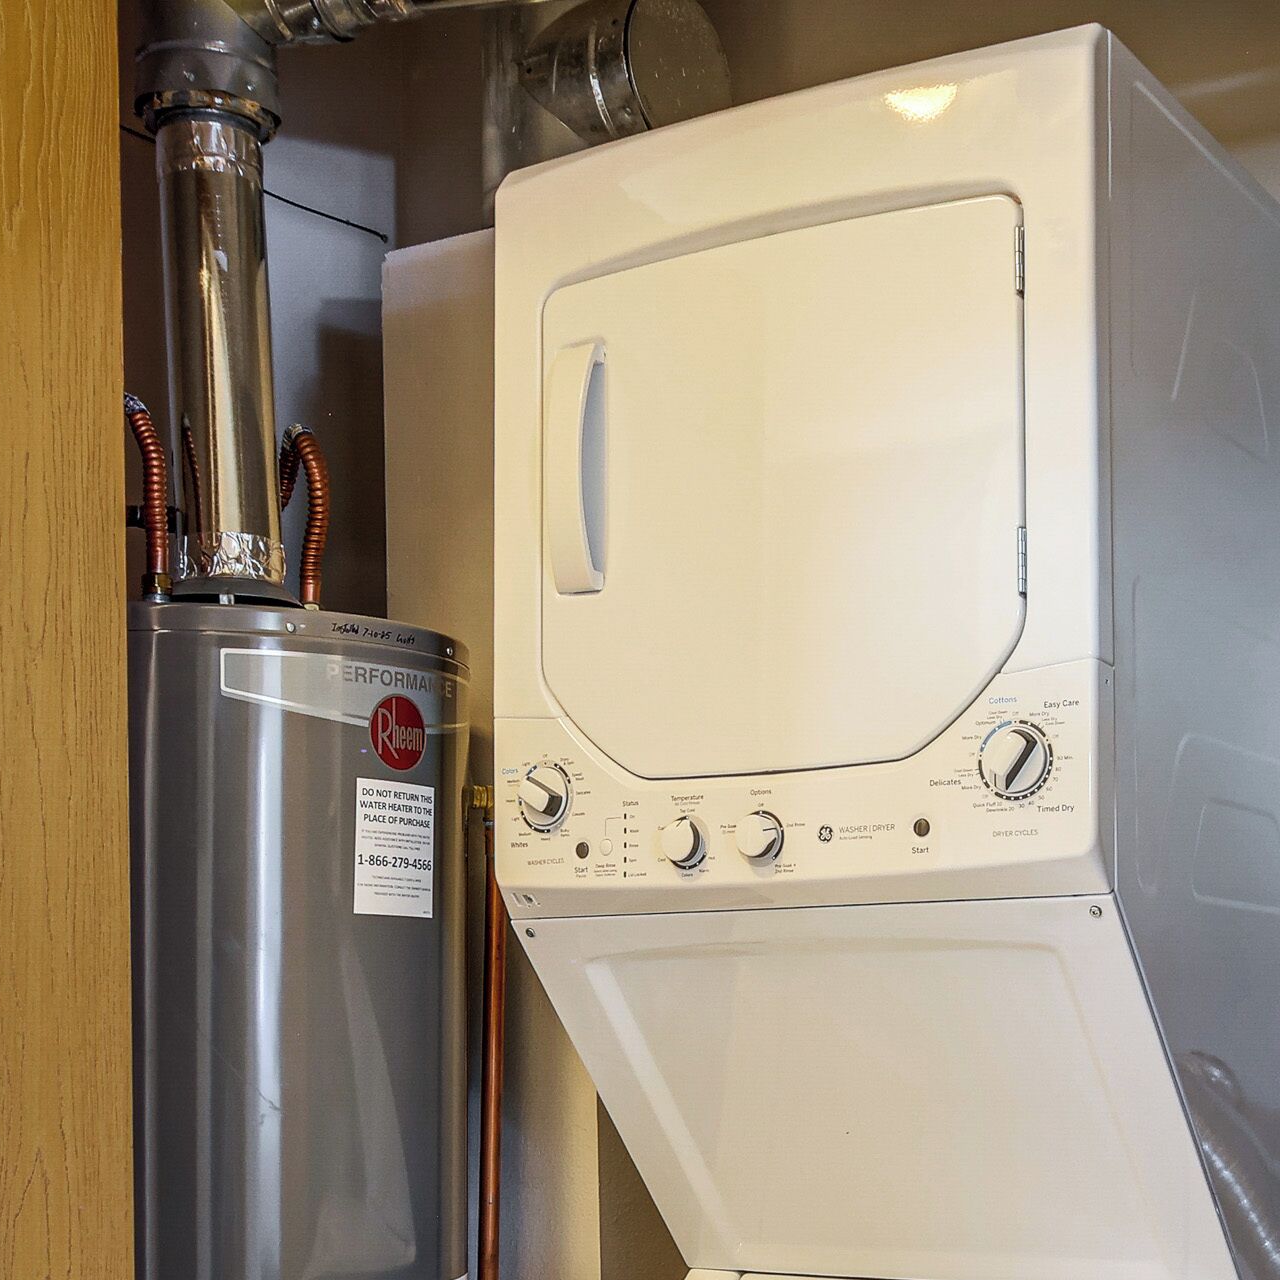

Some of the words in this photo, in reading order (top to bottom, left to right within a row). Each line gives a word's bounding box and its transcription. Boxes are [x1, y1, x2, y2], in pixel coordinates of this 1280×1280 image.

[988, 696, 1017, 704] Cottons
[1043, 701, 1061, 709] Easy
[377, 698, 423, 760] Rheem
[930, 779, 962, 787] Delicates
[362, 788, 374, 797] DO
[376, 789, 392, 798] NOT
[393, 791, 419, 802] RETURN
[420, 794, 433, 804] THIS
[359, 800, 387, 810] WATER
[388, 803, 413, 814] HEATER
[414, 806, 422, 815] TO
[423, 807, 433, 817] THE
[1037, 805, 1059, 813] Timed
[1061, 804, 1075, 813] Dry
[363, 813, 386, 824] PLACE
[388, 815, 398, 825] OF
[398, 817, 431, 829] PURCHASE
[839, 825, 868, 834] WASHER
[872, 824, 896, 832] DRYER
[992, 830, 1013, 838] DRYER
[1014, 829, 1039, 837] CYCLES
[911, 846, 929, 854] Start
[357, 853, 432, 872] 1-866-279-4566
